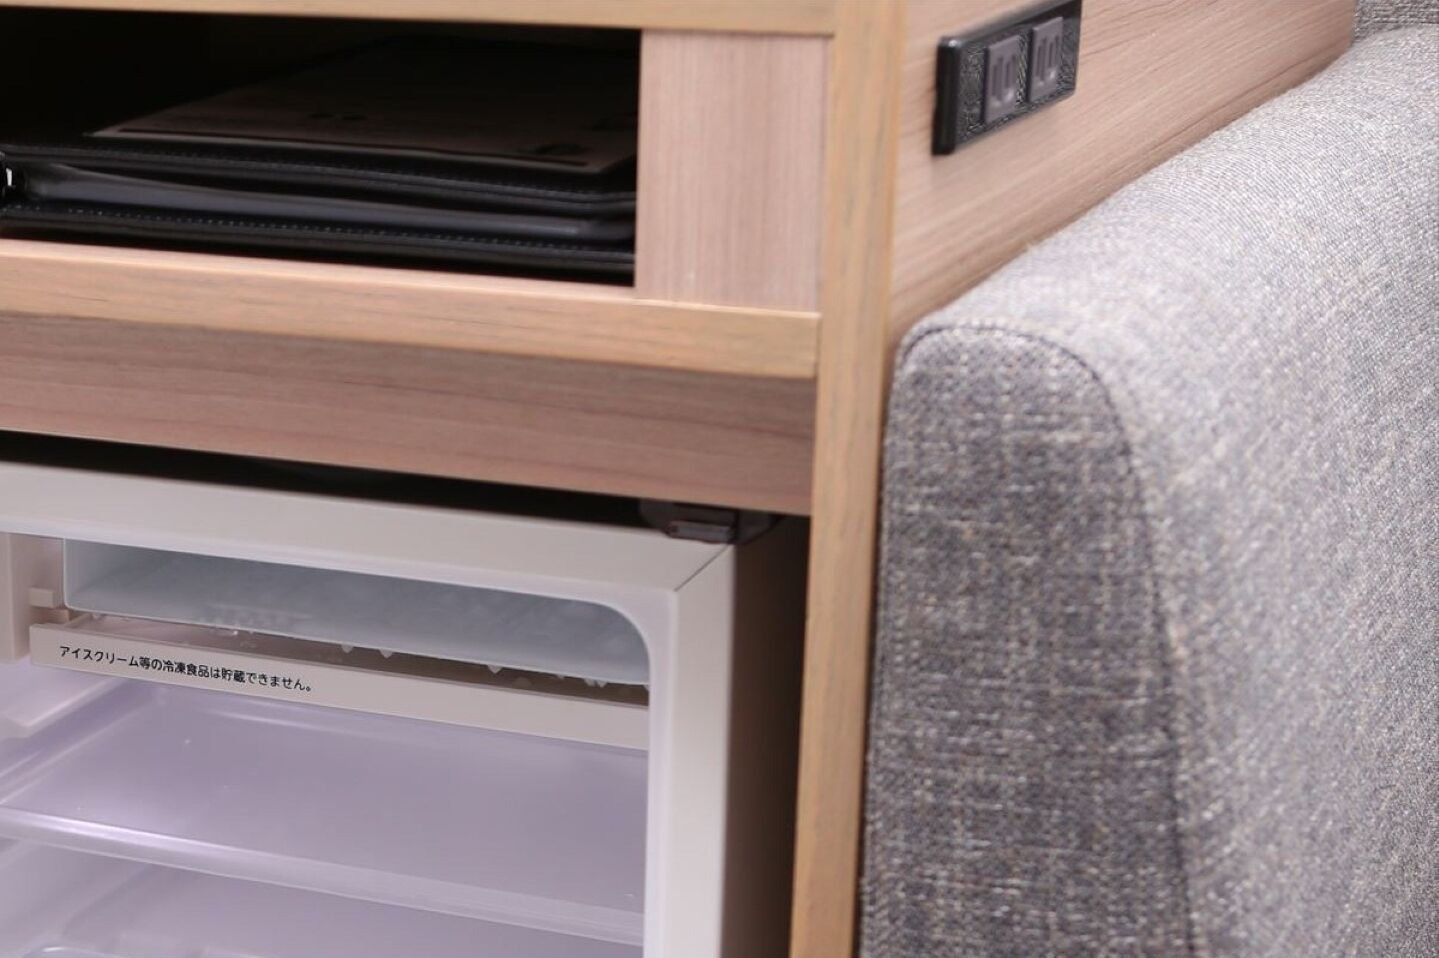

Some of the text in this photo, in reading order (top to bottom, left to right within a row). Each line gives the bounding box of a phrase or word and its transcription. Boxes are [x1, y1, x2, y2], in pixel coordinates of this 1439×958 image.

[60, 645, 311, 692] アイスクリーム等の冷凍食品は貯蔵できません。
